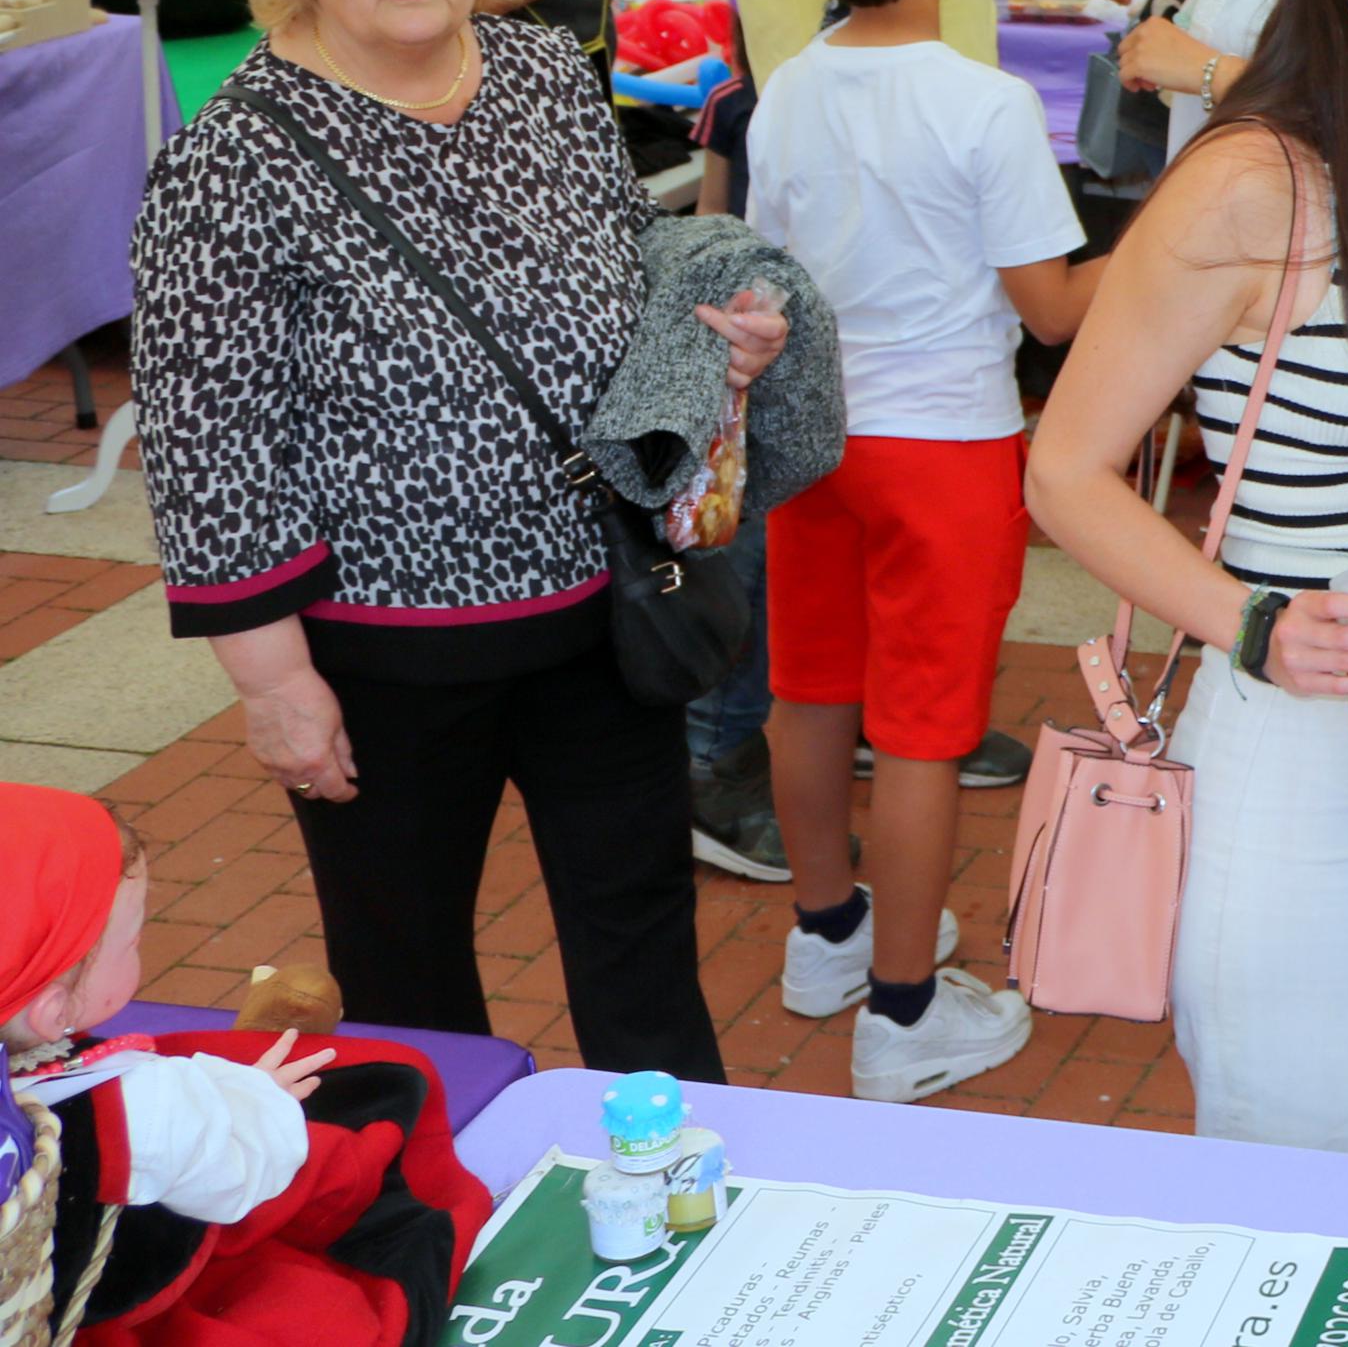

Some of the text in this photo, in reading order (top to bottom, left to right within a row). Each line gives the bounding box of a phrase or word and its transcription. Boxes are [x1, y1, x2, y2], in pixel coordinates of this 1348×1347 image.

[775, 1219, 829, 1279] Reumas
[797, 1259, 850, 1321] Anginas
[850, 1202, 890, 1245] Pieles
[973, 1218, 1048, 1285] Natural
[1168, 1241, 1217, 1299] Caballo,
[450, 1277, 543, 1347] da
[696, 1273, 764, 1347] Picaduras
[770, 1248, 834, 1321] Tendinitis
[1062, 1274, 1108, 1326] Salvia,
[1102, 1258, 1149, 1309] Buena,
[1126, 1255, 1181, 1320] Lavanda,
[1157, 1303, 1180, 1321] de
